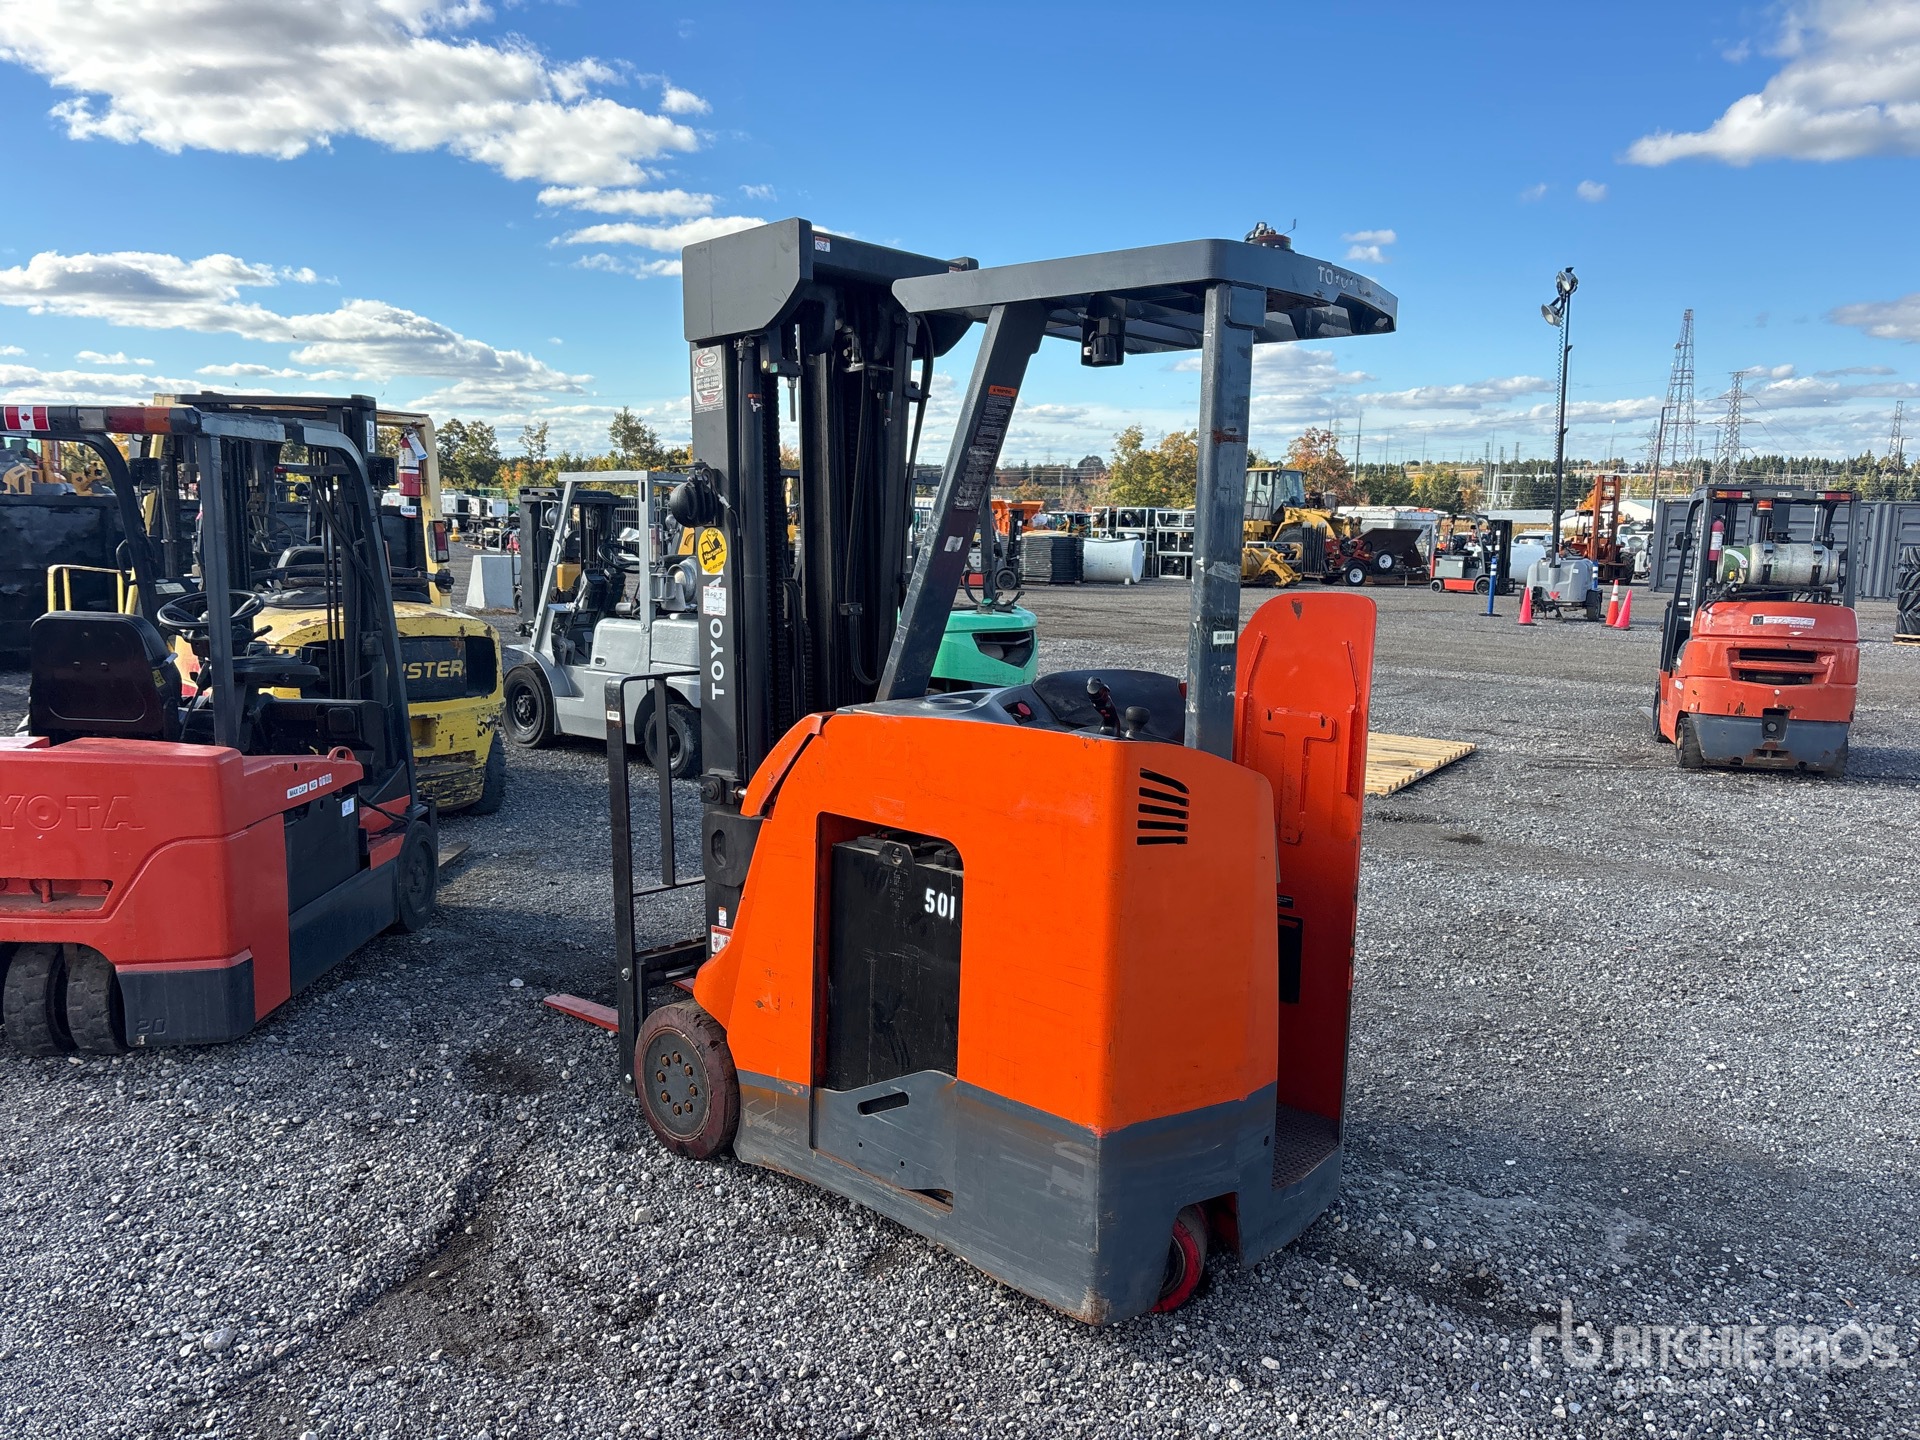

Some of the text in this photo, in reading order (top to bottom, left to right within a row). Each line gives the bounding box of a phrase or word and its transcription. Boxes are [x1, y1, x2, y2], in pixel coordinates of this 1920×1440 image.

[402, 658, 465, 680] STER
[299, 785, 307, 793] CAP
[924, 887, 956, 920] 501
[135, 1017, 167, 1036] 20
